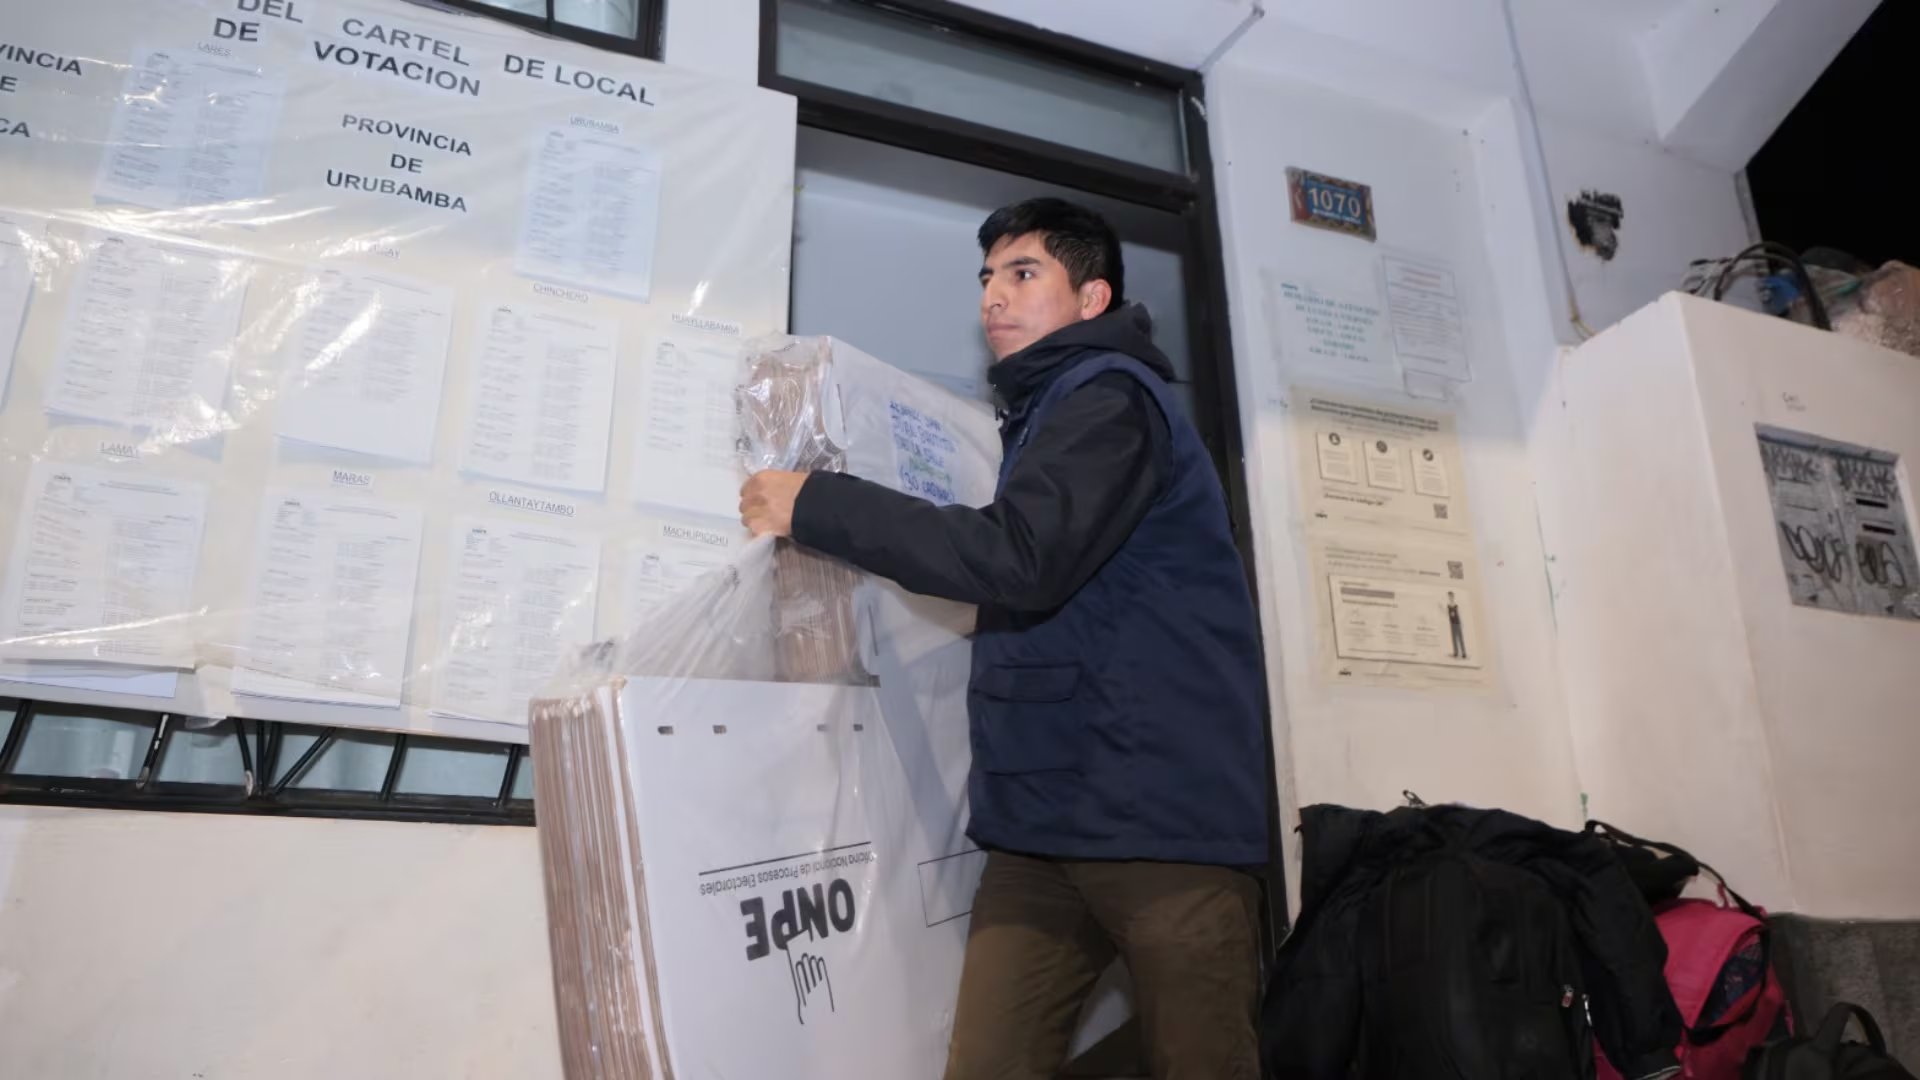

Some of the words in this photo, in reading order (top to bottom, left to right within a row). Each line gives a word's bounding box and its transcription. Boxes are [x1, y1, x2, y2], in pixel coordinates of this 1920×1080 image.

[213, 17, 260, 42] DE
[313, 41, 480, 96] VOTACION
[237, 0, 303, 24] DEL
[342, 18, 470, 66] CARTEL
[504, 54, 545, 79] DE
[555, 65, 655, 106] LOCAL
[342, 114, 472, 156] PROVINCIA
[390, 153, 424, 173] DE
[326, 169, 467, 213] URUBAMBA
[1308, 187, 1361, 218] 1070
[332, 469, 371, 487] MARAS
[488, 490, 574, 516] OLLANTAYTAMBO
[663, 525, 728, 546] MACHUPICCHU
[758, 865, 799, 884] Procesos
[799, 862, 811, 875] de
[813, 854, 848, 873] Nacional
[700, 874, 756, 896] Electorales
[740, 878, 855, 961] ONPE
